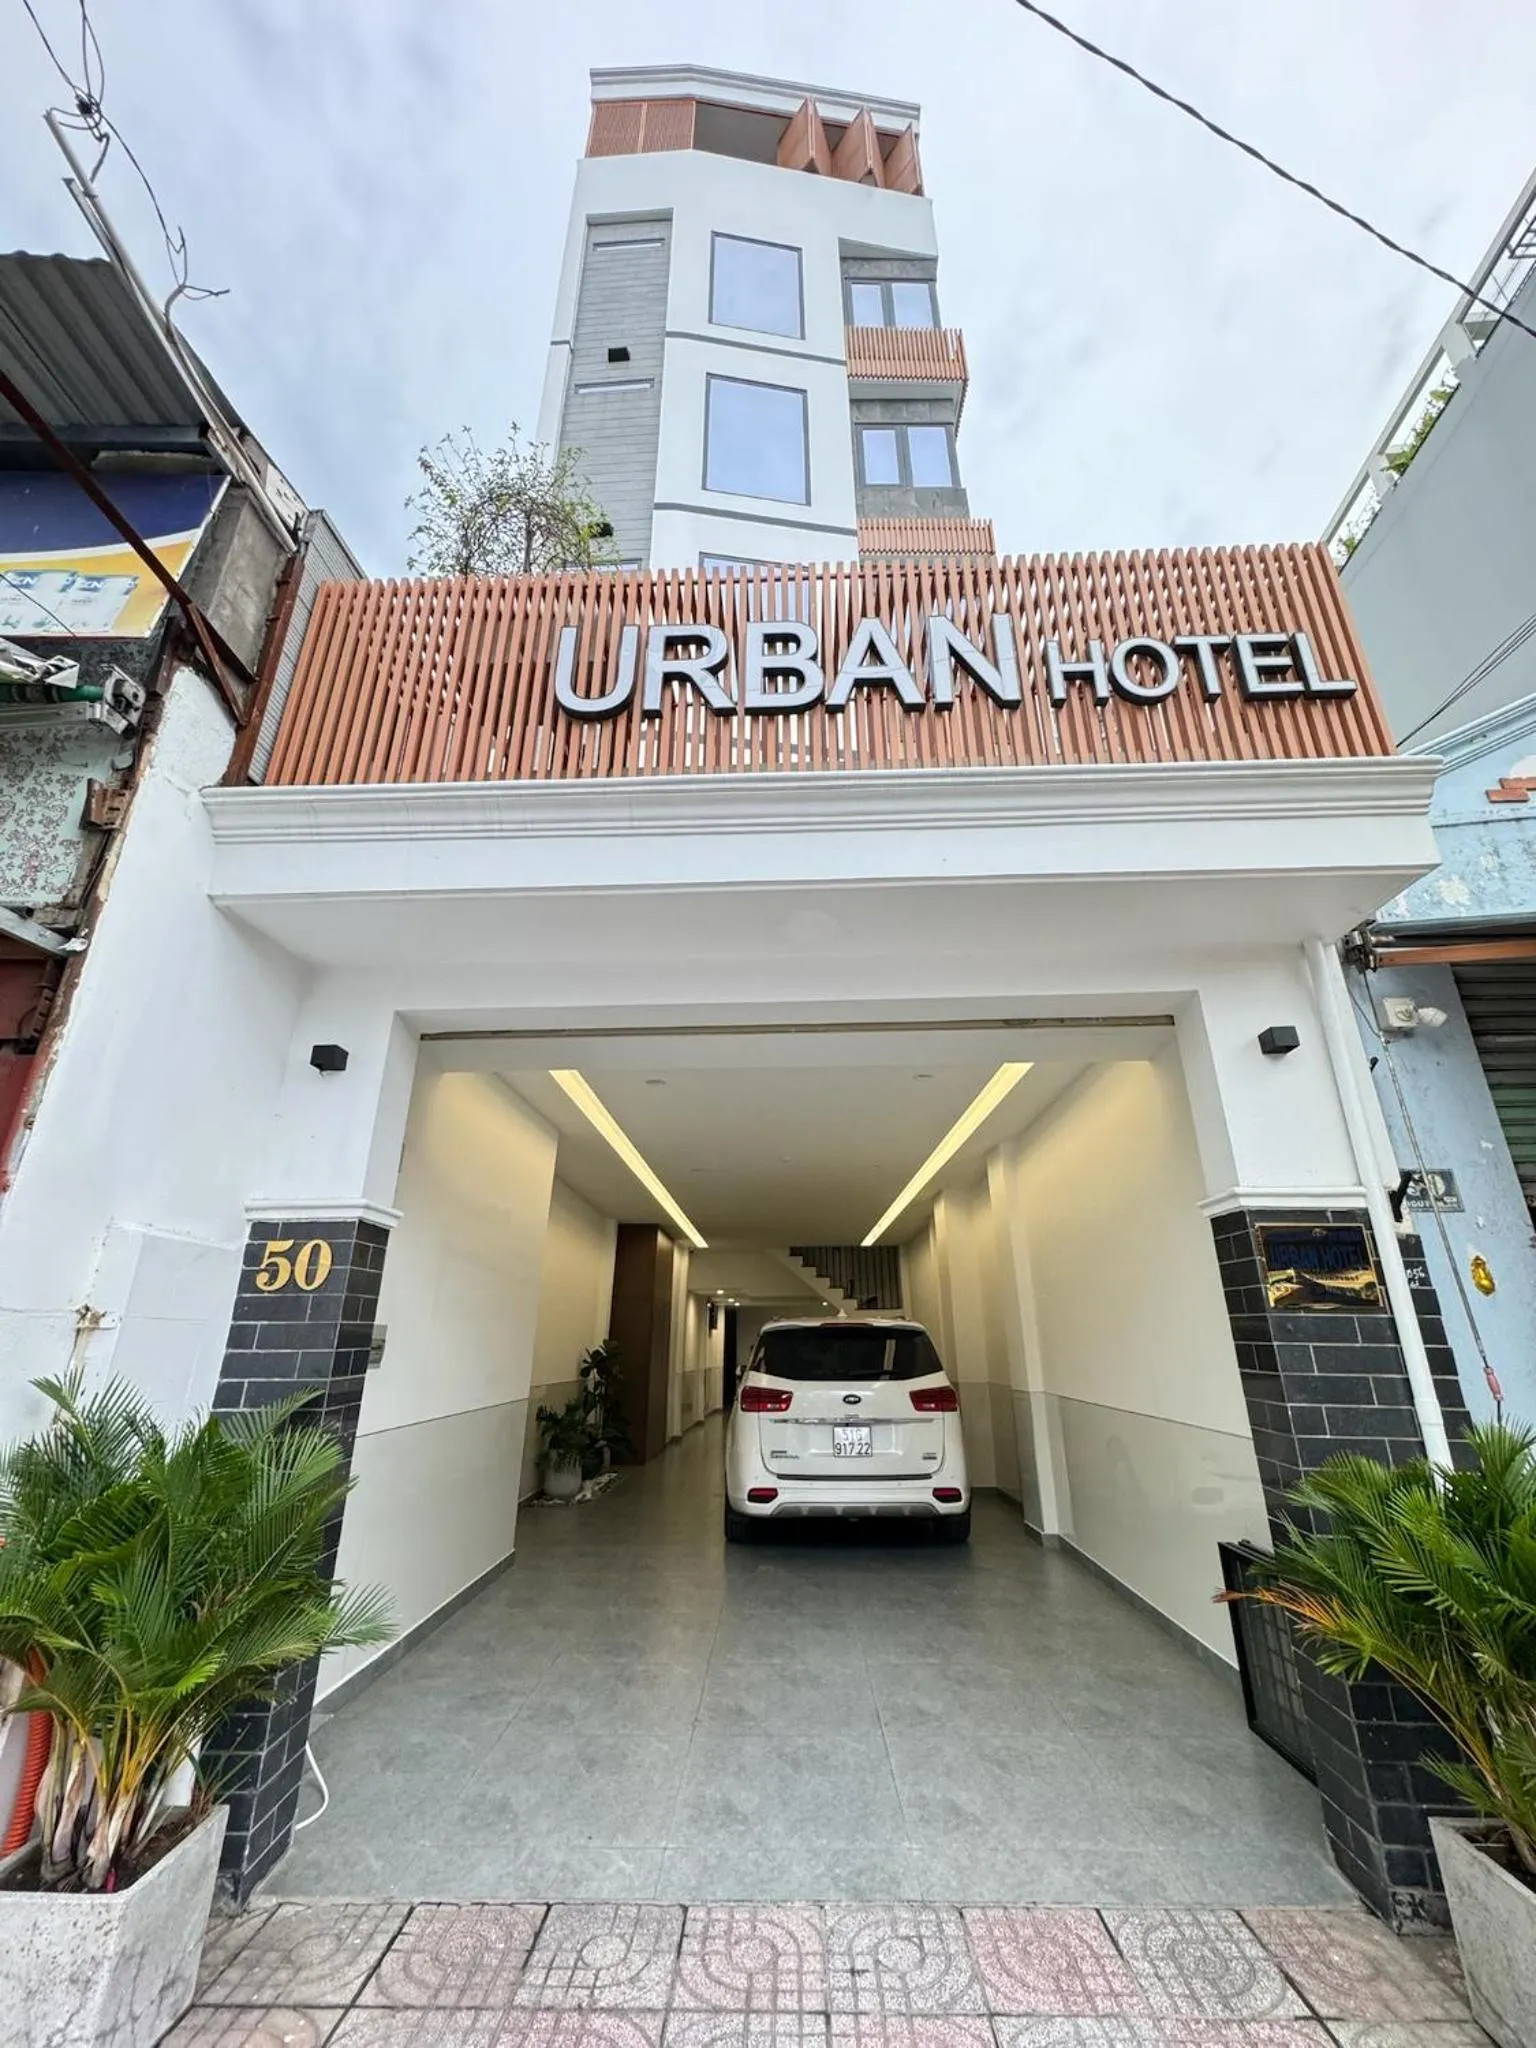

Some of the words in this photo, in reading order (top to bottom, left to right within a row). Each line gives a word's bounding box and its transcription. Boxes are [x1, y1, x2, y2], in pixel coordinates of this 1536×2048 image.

[554, 613, 1021, 720] URBAN
[1047, 631, 1357, 707] HOTEL
[255, 1238, 334, 1293] 50
